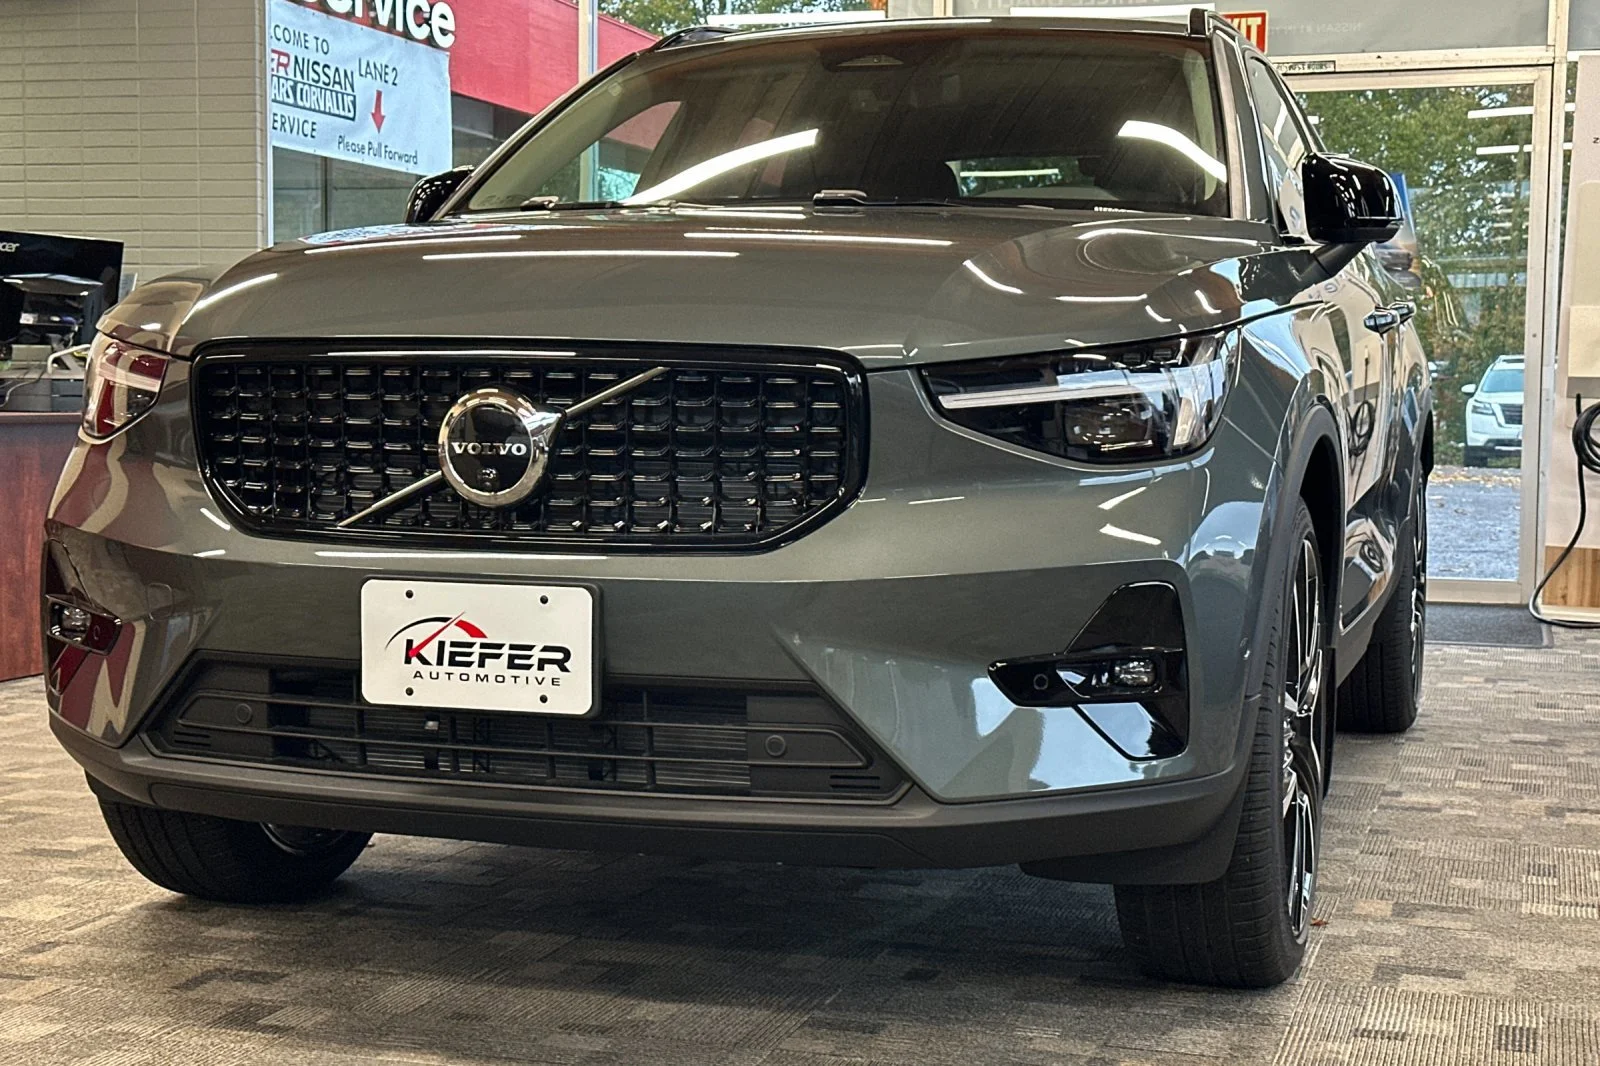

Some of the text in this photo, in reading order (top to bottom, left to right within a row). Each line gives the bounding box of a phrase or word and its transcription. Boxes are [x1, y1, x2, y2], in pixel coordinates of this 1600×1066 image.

[270, 24, 330, 55] COME TO
[293, 55, 355, 93] NISSAN
[358, 57, 398, 86] LANE 2
[296, 81, 355, 119] CORVALLIS
[337, 135, 418, 165] Please Pull Forward
[451, 442, 527, 456] VOLVO
[404, 638, 572, 673] KIEFER
[413, 670, 562, 687] AUTOMOTIVE
